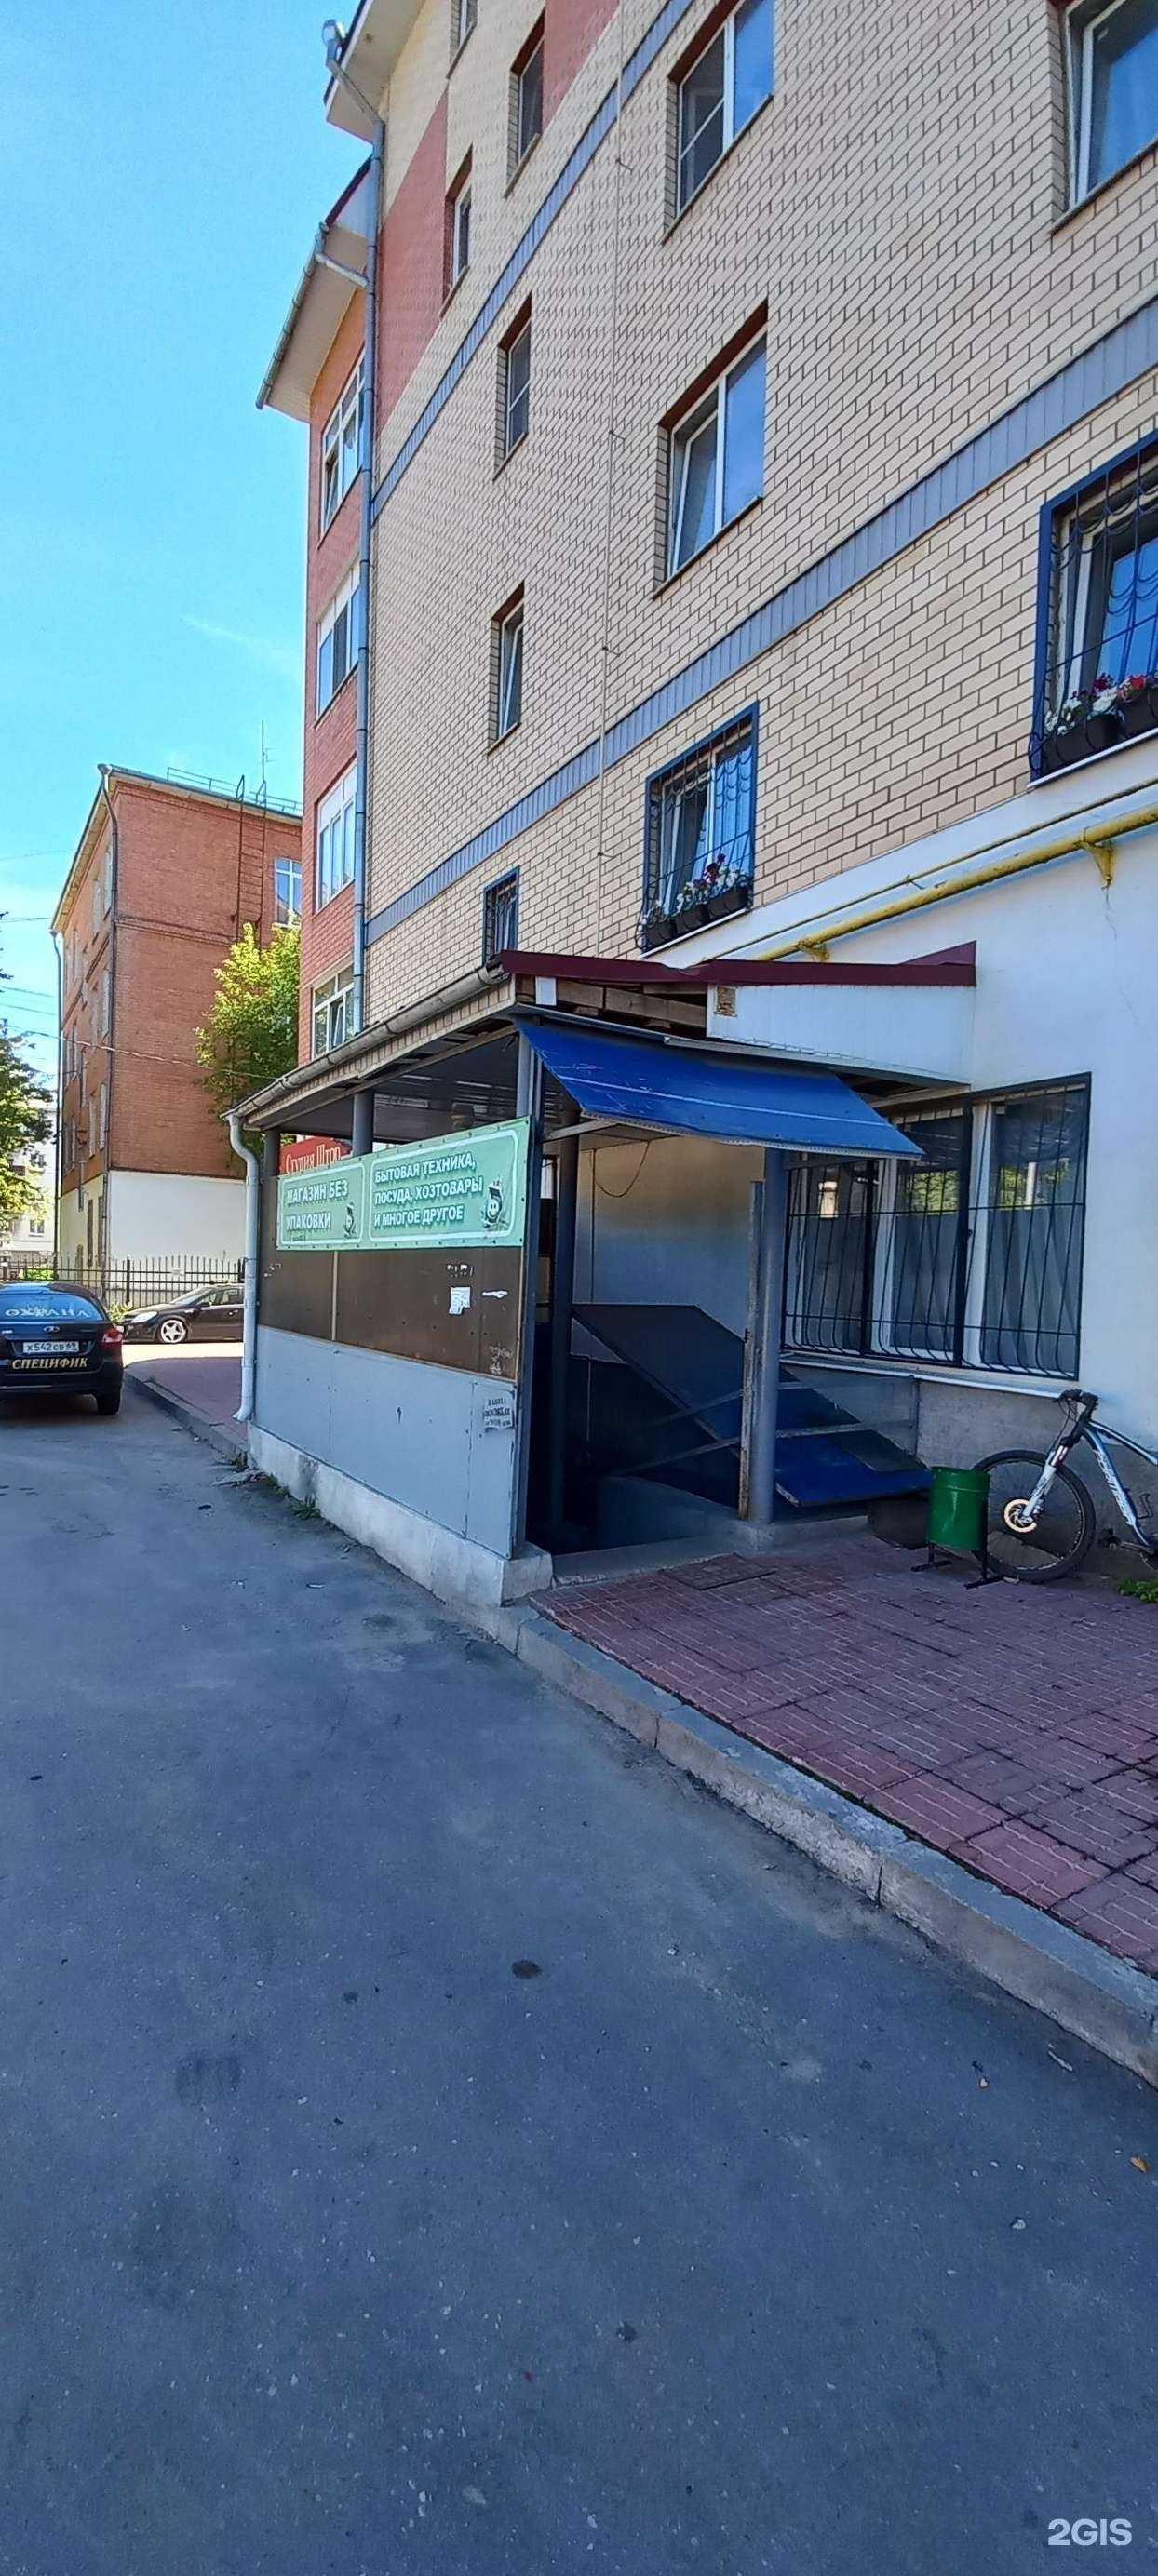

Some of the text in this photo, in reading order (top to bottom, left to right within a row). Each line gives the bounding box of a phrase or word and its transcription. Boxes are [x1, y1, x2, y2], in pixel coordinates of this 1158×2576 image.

[374, 1154, 476, 1183] БЫТОВАЯ ТЕХНИКА,
[287, 1179, 348, 1204] МАГАЗИН БЕЗ
[374, 1177, 483, 1206] ПОСУДА, ХОЗТОВАРЫ
[286, 1212, 331, 1231] УПАКОВКИ
[374, 1205, 464, 1227] И МНОГОЕ ДРУГОЕ
[5, 1308, 91, 1318] ОХРАНА
[12, 1357, 88, 1370] СПЕЦИФИК
